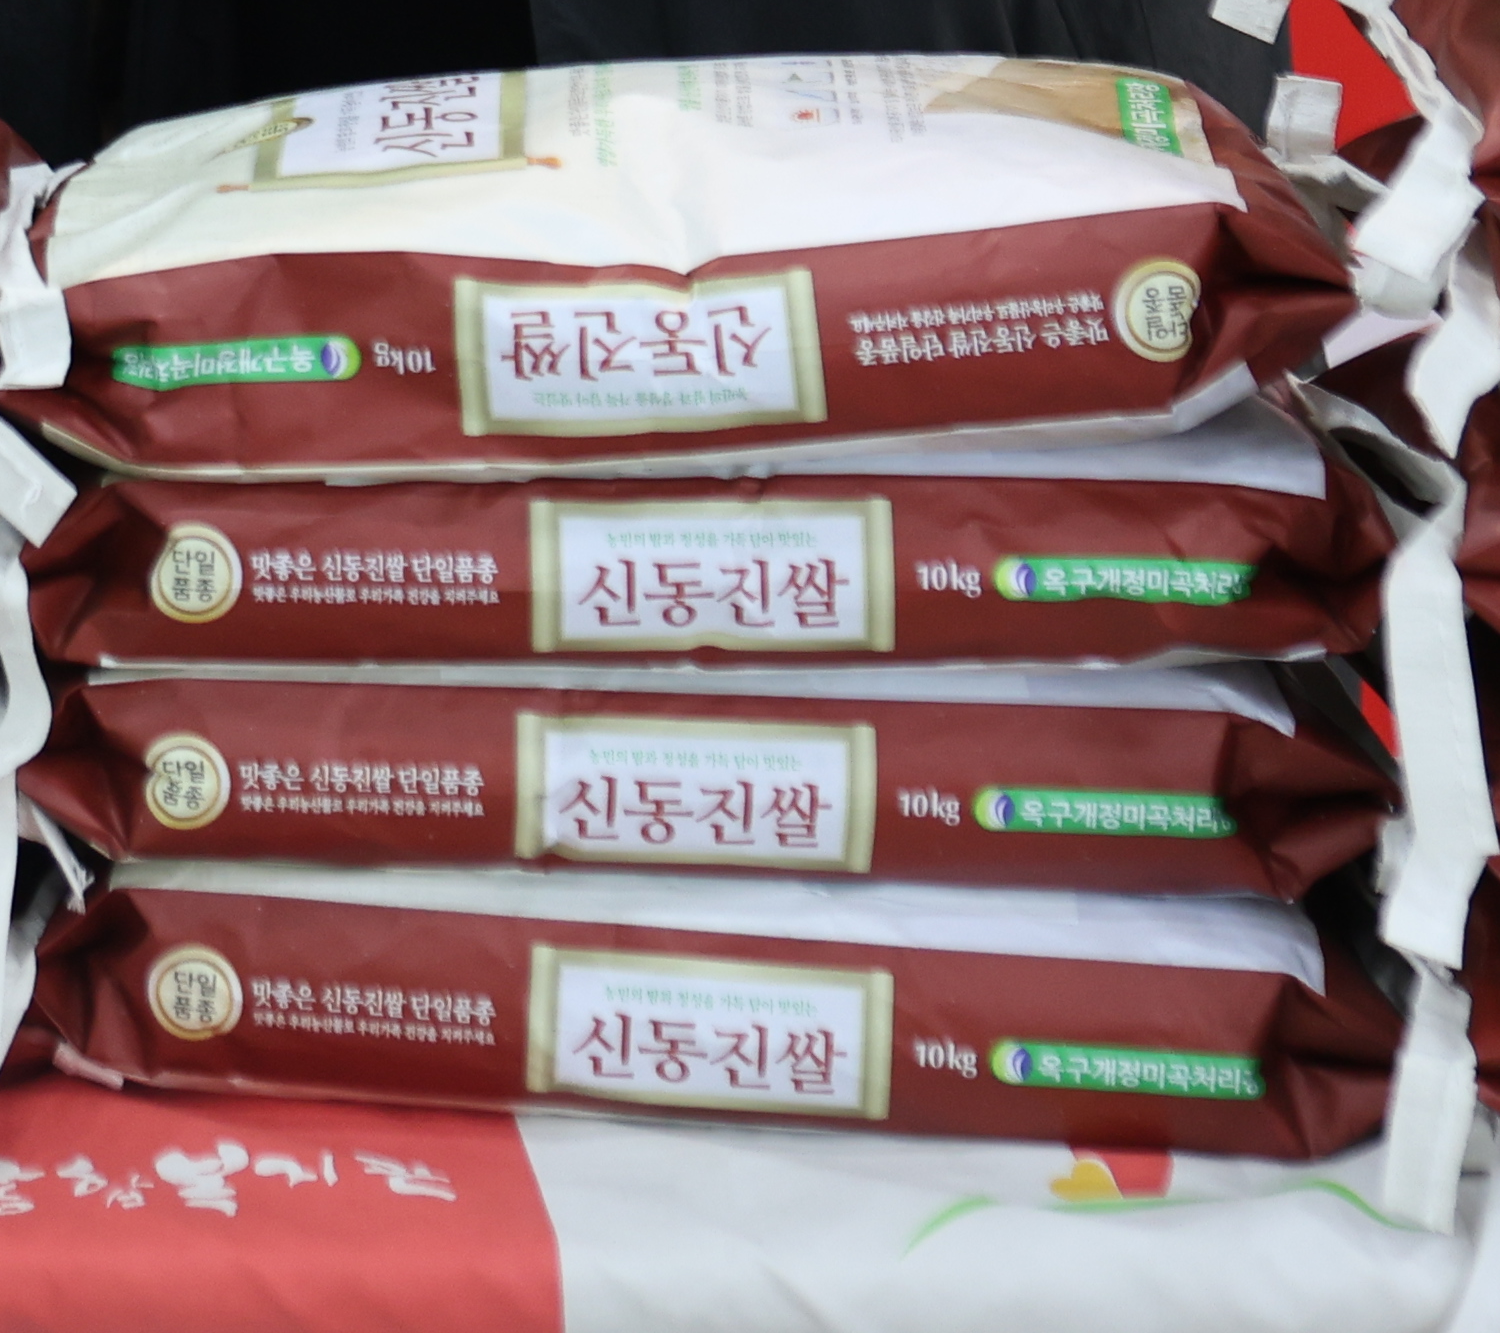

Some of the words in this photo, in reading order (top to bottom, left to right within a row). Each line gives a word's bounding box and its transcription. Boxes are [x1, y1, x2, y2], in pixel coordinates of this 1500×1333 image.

[173, 549, 216, 576] 단일
[250, 551, 316, 581] 맛좋은
[322, 553, 408, 582] 신동진쌀
[410, 553, 498, 584] 단일품종
[917, 560, 981, 597] 10kg
[580, 559, 848, 628] 신동진쌀
[239, 762, 304, 790] 맛좋은
[311, 764, 394, 793] 신동진쌀
[397, 766, 484, 796] 단일품종
[560, 776, 830, 847] 신동진쌀
[899, 789, 960, 825] 10kg
[251, 980, 315, 1015] 맛좋은
[322, 986, 407, 1018] 신동진쌀
[410, 993, 496, 1025] 단일품종
[574, 1013, 845, 1094] 신동진쌀
[914, 1040, 977, 1077] 10kg
